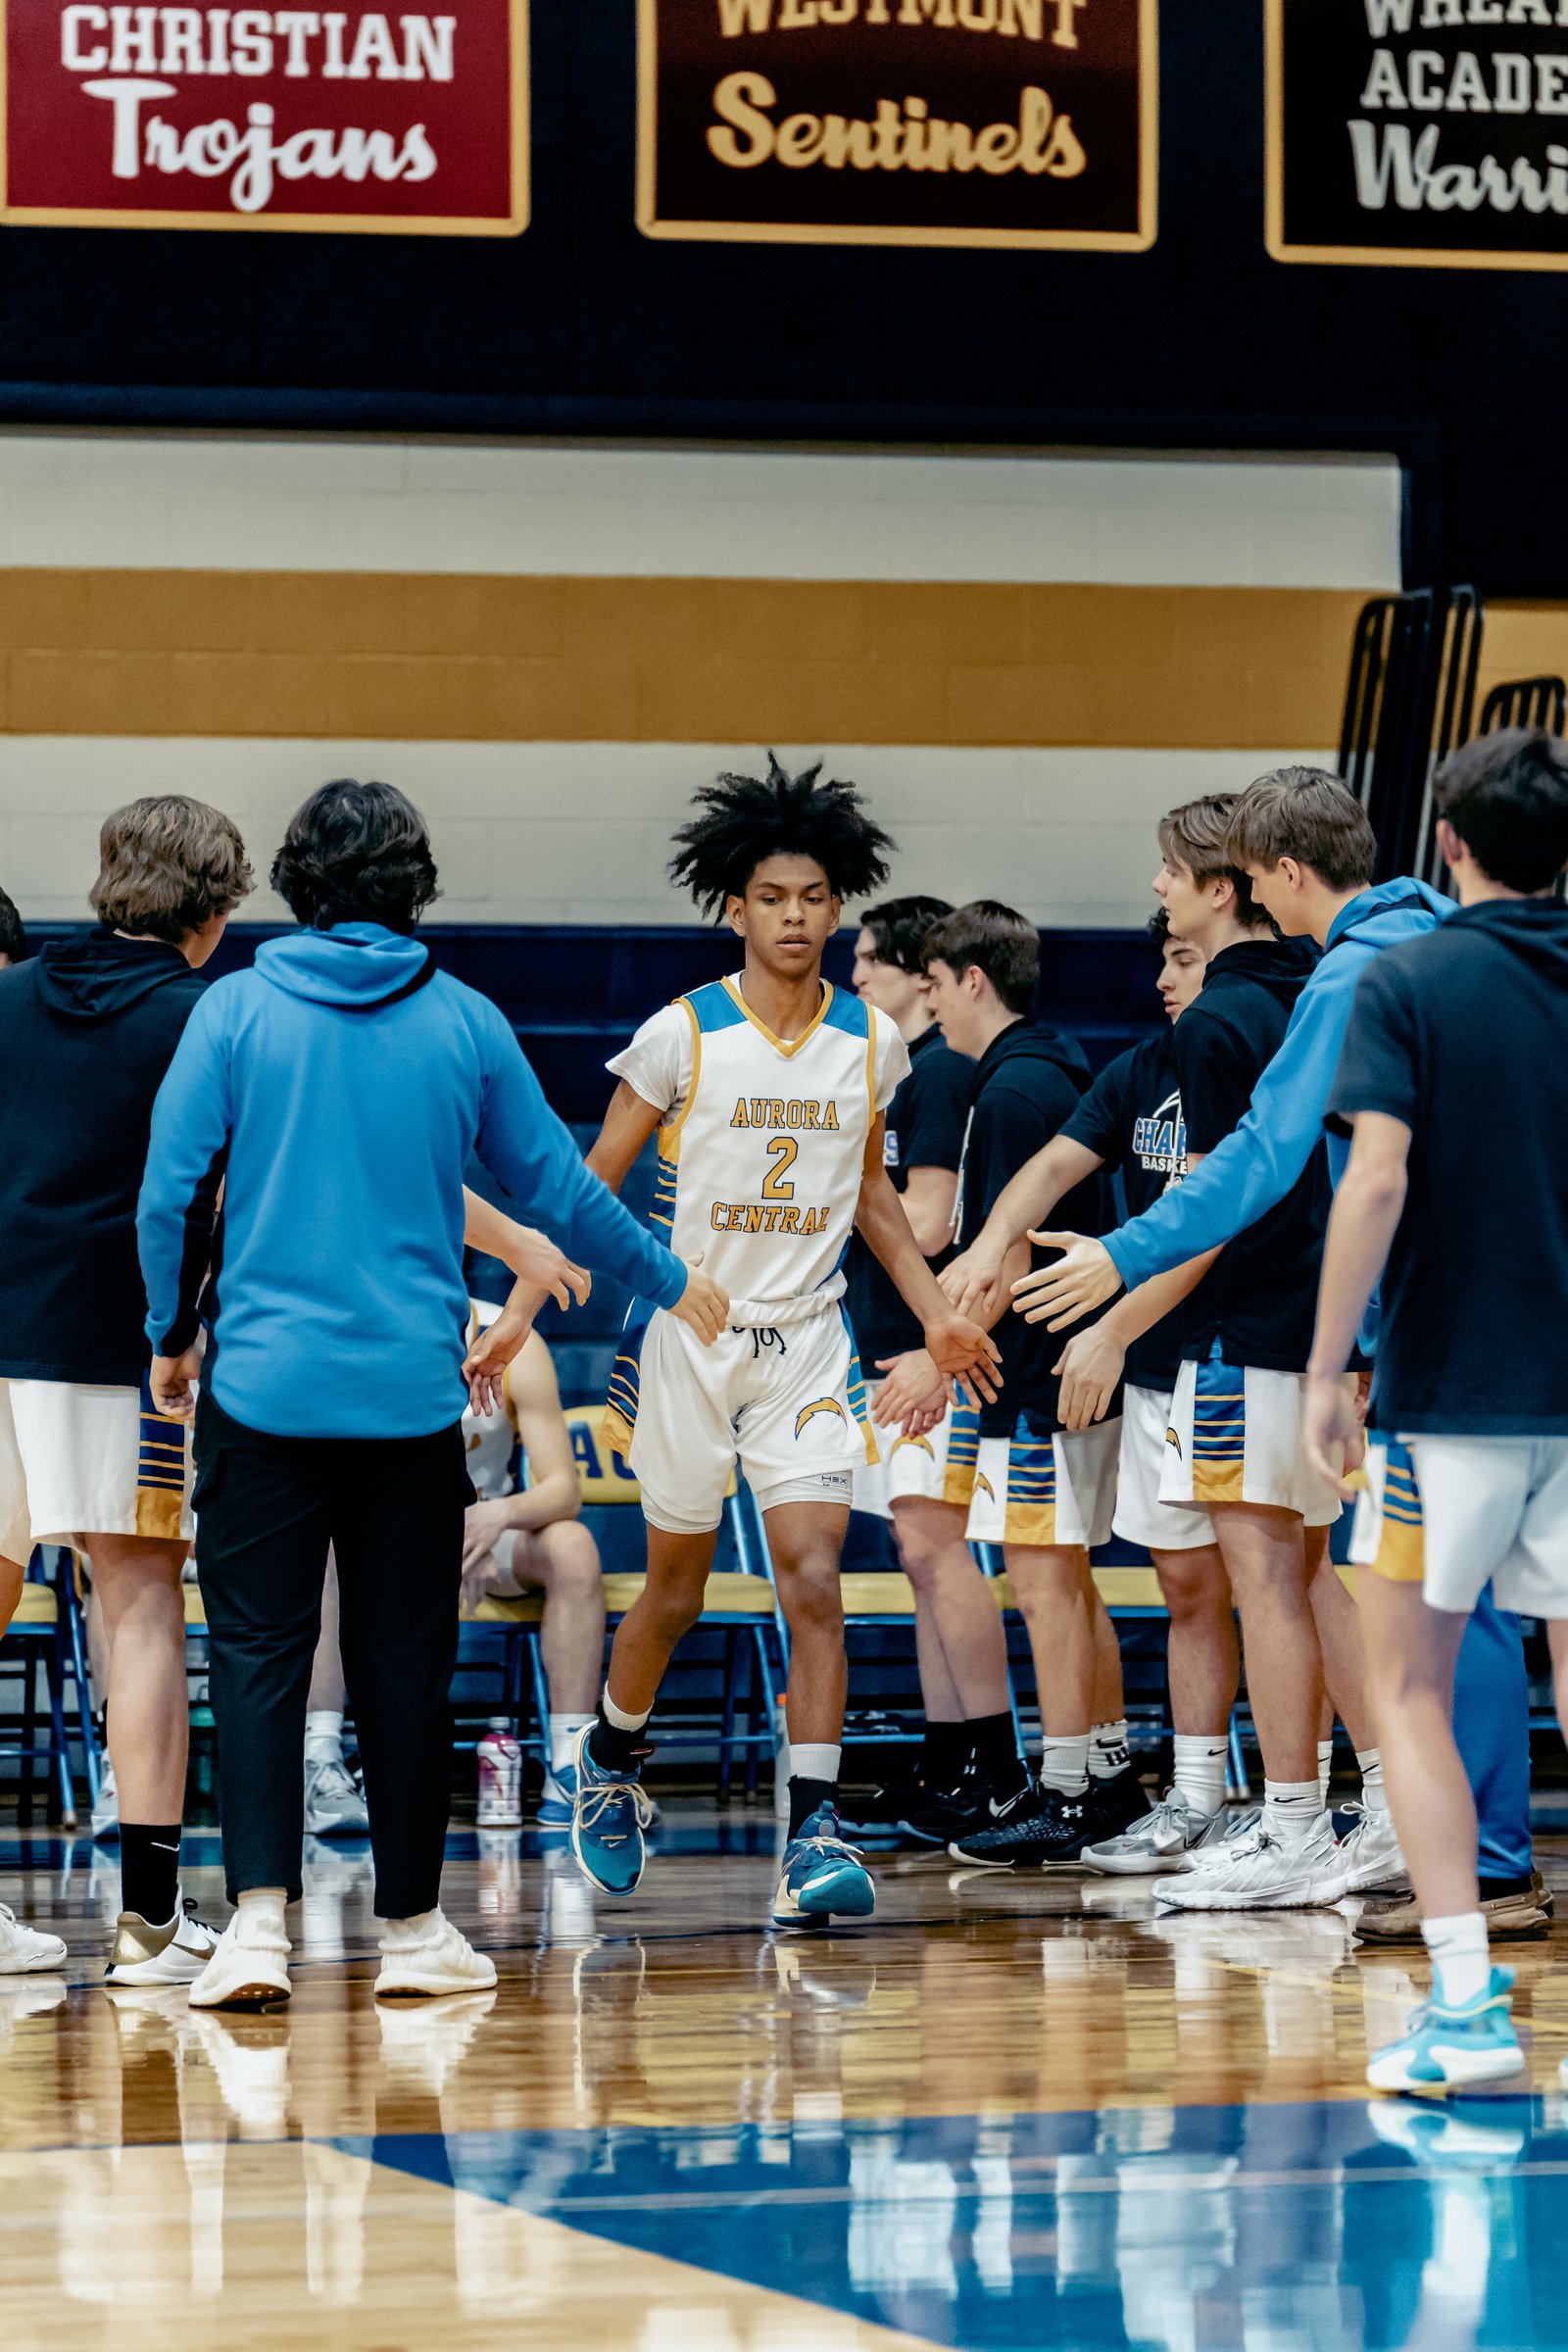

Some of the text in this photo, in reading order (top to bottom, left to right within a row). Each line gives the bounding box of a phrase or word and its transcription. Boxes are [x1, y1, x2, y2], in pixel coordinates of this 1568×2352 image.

[60, 4, 457, 81] CHRISTIAN
[1359, 48, 1568, 116] ACADE
[80, 77, 437, 214] Trojans
[706, 71, 1088, 178] Sentinels
[1347, 119, 1568, 215] Warri
[729, 1098, 840, 1131] AURORA
[761, 1136, 799, 1200] 2
[710, 1201, 830, 1236] CENTRAL
[821, 1475, 848, 1485] HEX
